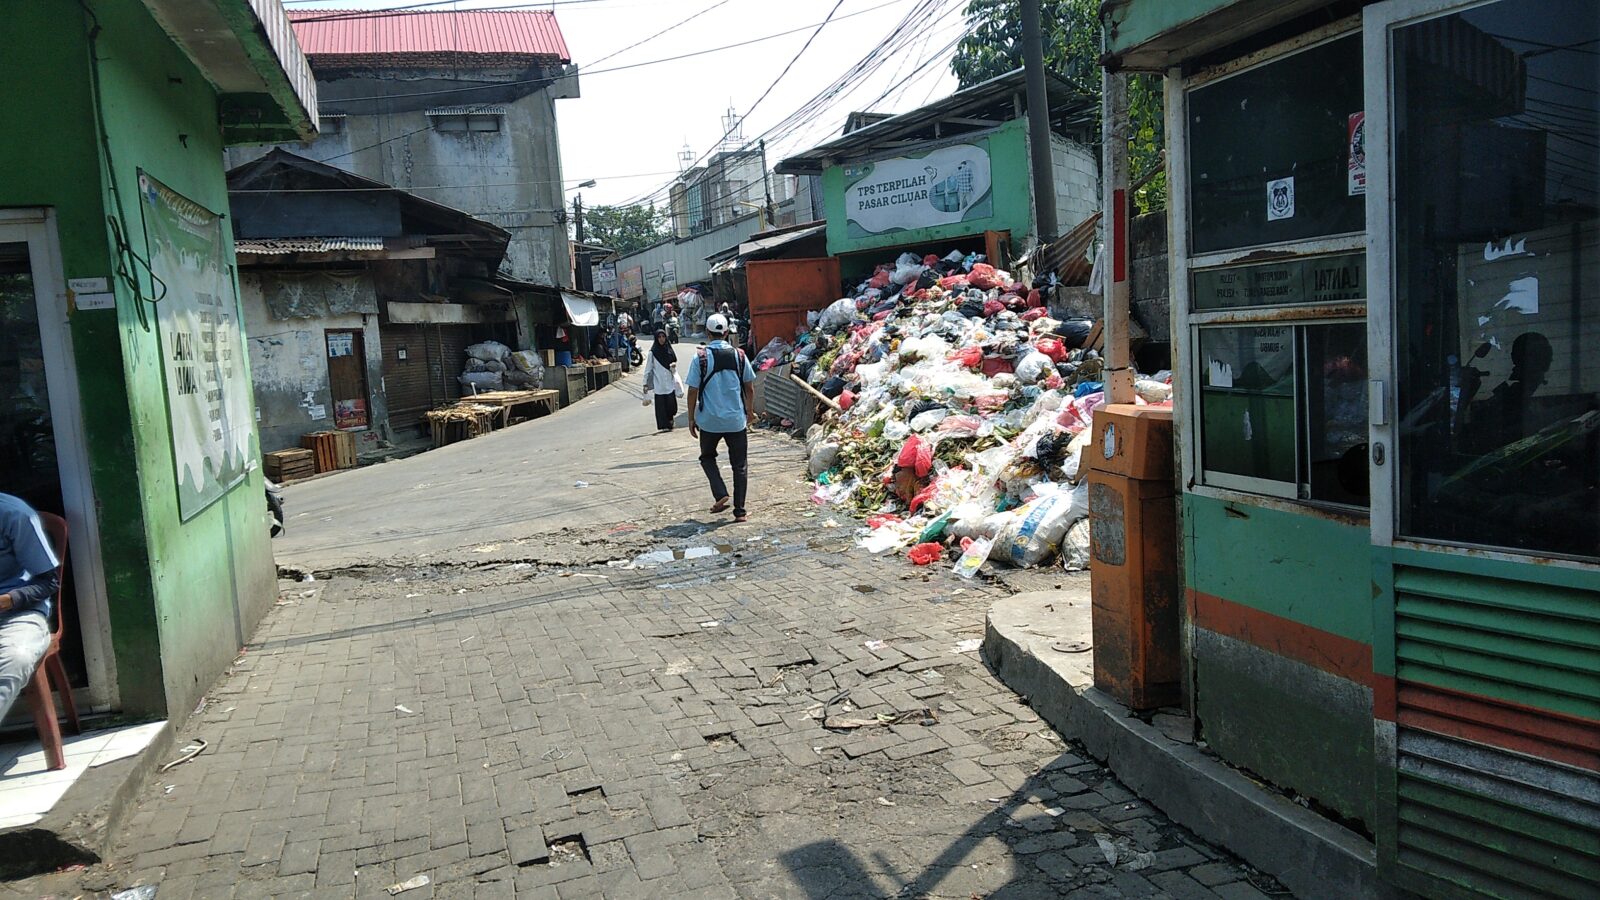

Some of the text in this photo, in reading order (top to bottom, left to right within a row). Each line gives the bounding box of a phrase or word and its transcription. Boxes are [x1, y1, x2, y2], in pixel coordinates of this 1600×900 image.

[857, 175, 927, 197] TPS TERPILAH
[858, 189, 928, 211] PASAR CILUAR
